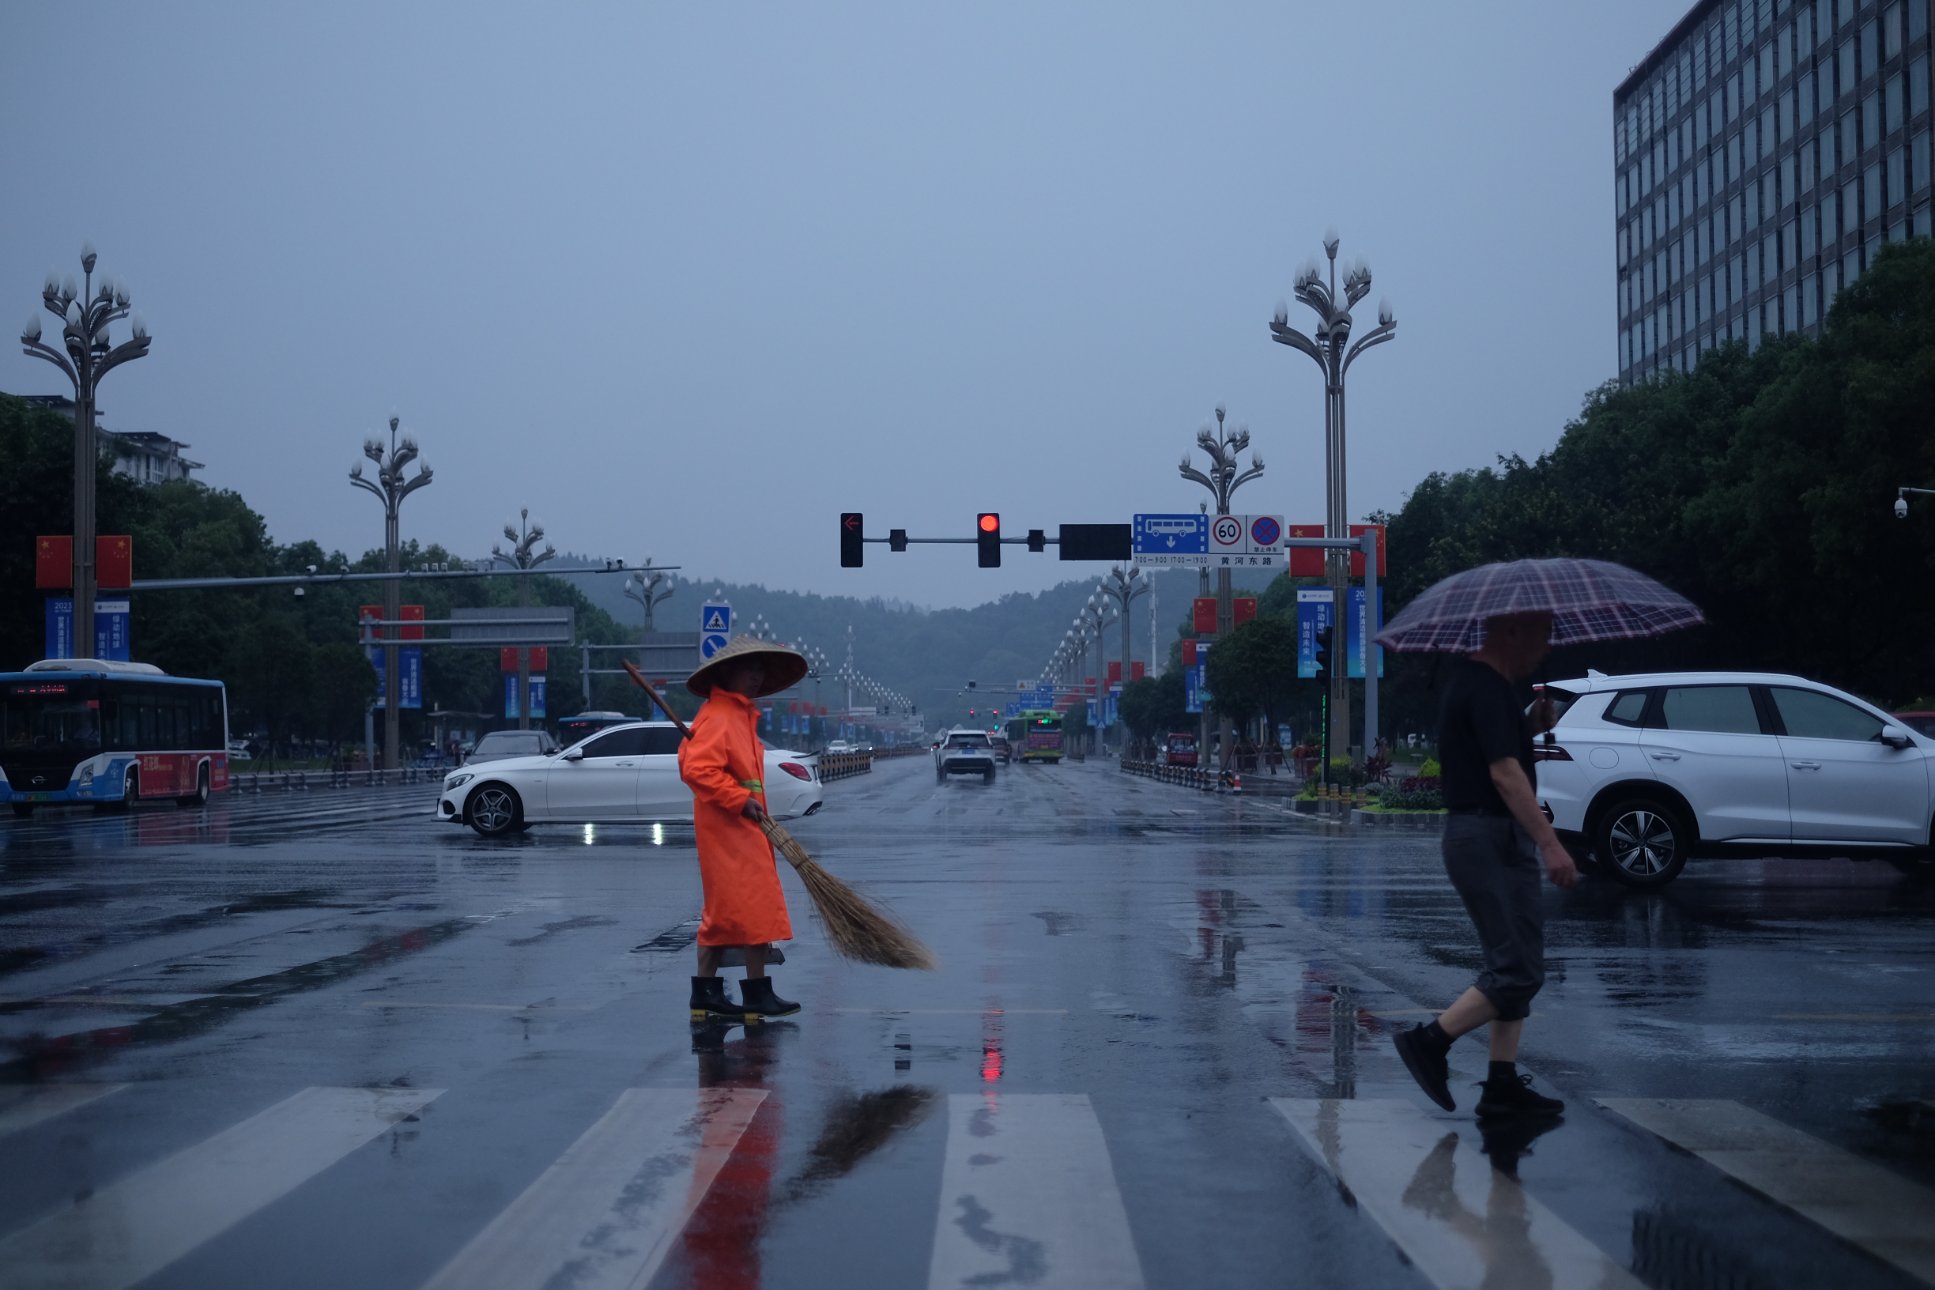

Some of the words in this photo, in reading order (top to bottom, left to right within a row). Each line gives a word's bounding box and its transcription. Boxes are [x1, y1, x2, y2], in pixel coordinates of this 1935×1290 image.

[1218, 524, 1236, 538] 60
[1221, 556, 1272, 566] 黄河东路
[1317, 604, 1325, 632] 绿动地
